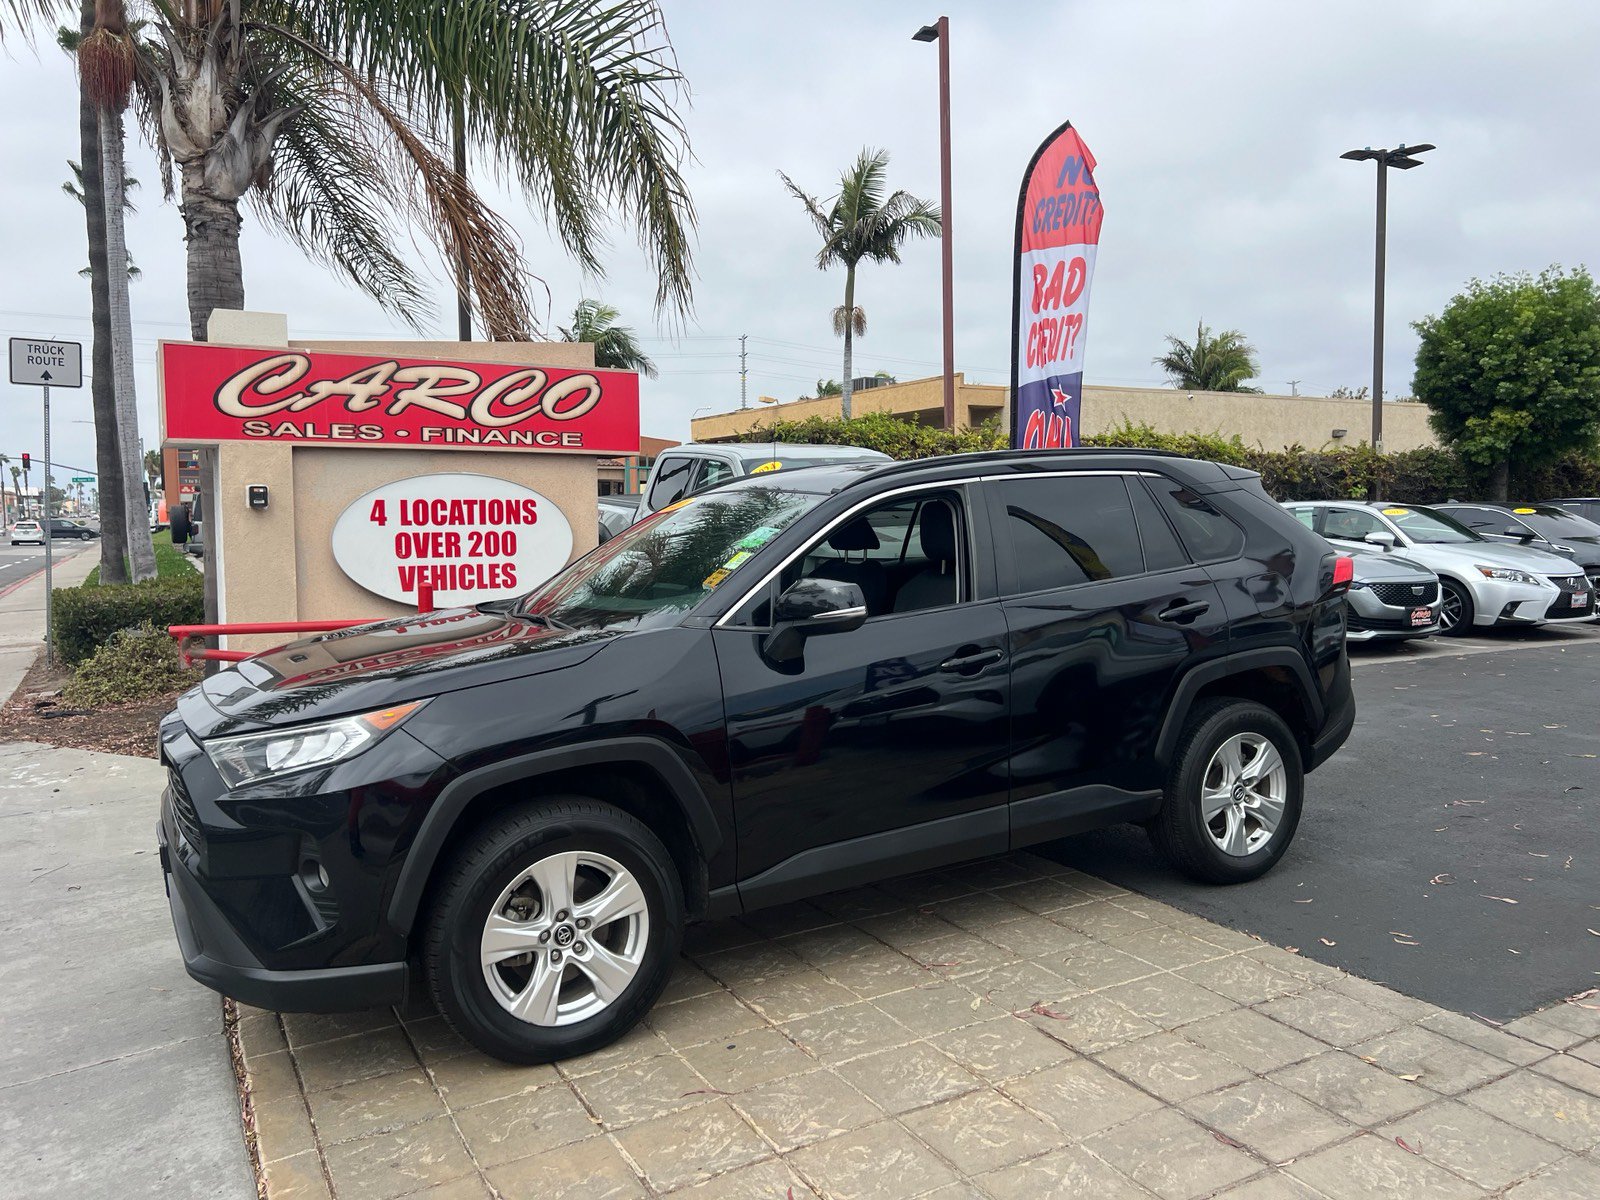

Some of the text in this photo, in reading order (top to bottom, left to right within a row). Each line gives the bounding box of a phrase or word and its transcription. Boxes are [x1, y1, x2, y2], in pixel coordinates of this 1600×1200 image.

[1032, 191, 1100, 235] CREDIT?
[1031, 256, 1087, 315] BAD
[27, 343, 65, 355] TRUCK
[1026, 312, 1083, 369] CREDIT?
[27, 355, 65, 367] ROUTE
[213, 354, 602, 427] CARCO
[242, 420, 584, 447] SALES FINANCE
[370, 499, 537, 526] 4 LOCATIONS
[394, 530, 518, 559] OVER 200
[398, 563, 518, 592] VEHICLES
